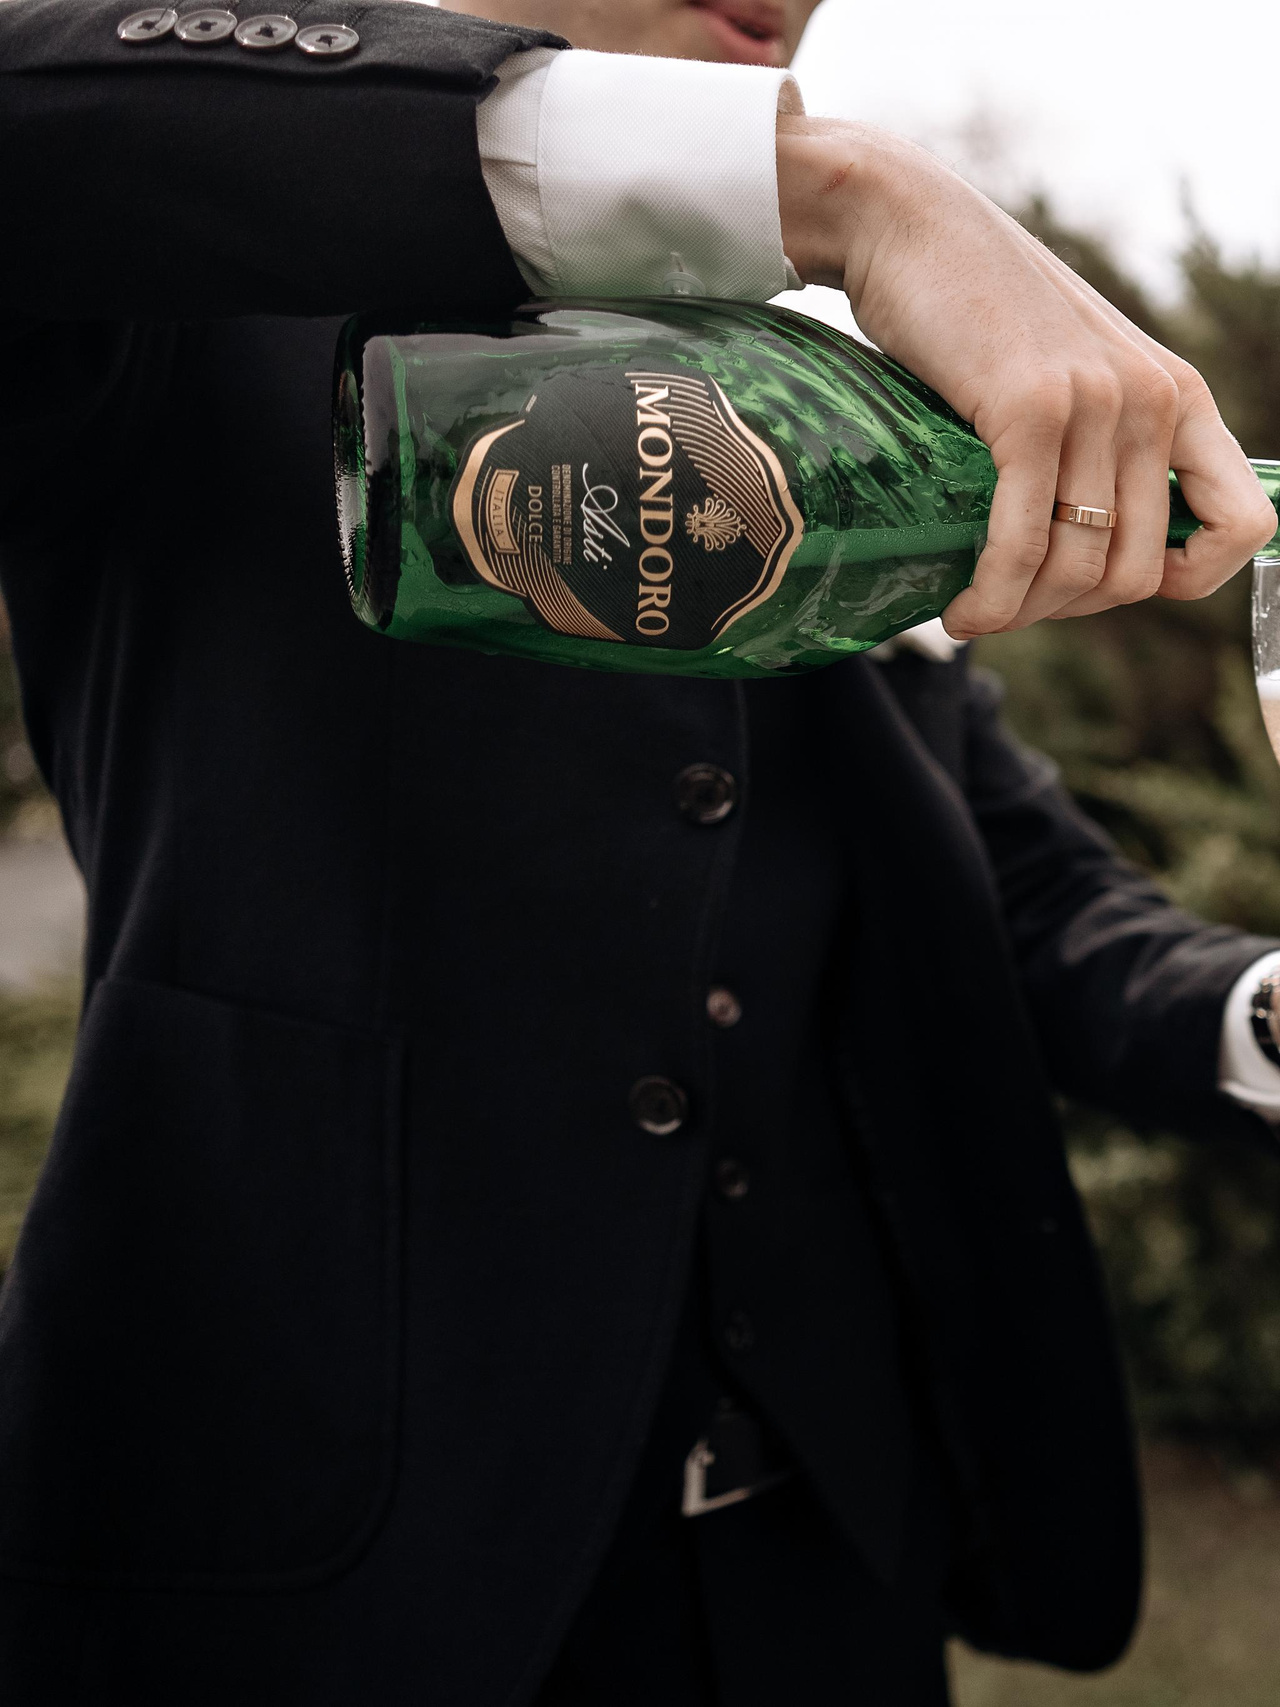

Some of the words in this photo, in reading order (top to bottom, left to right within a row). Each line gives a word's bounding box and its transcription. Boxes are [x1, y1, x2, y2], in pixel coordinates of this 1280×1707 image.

[492, 489, 505, 536] ITALIA
[527, 485, 543, 544] DOLCE
[551, 464, 561, 517] CONTROLLATA
[562, 464, 572, 525] DENOMINAZIONE
[580, 463, 630, 570] Asti
[634, 383, 675, 636] MONDORO
[552, 525, 561, 563] GARANTITA
[563, 527, 571, 535] DI
[563, 537, 572, 565] ORIGINE
